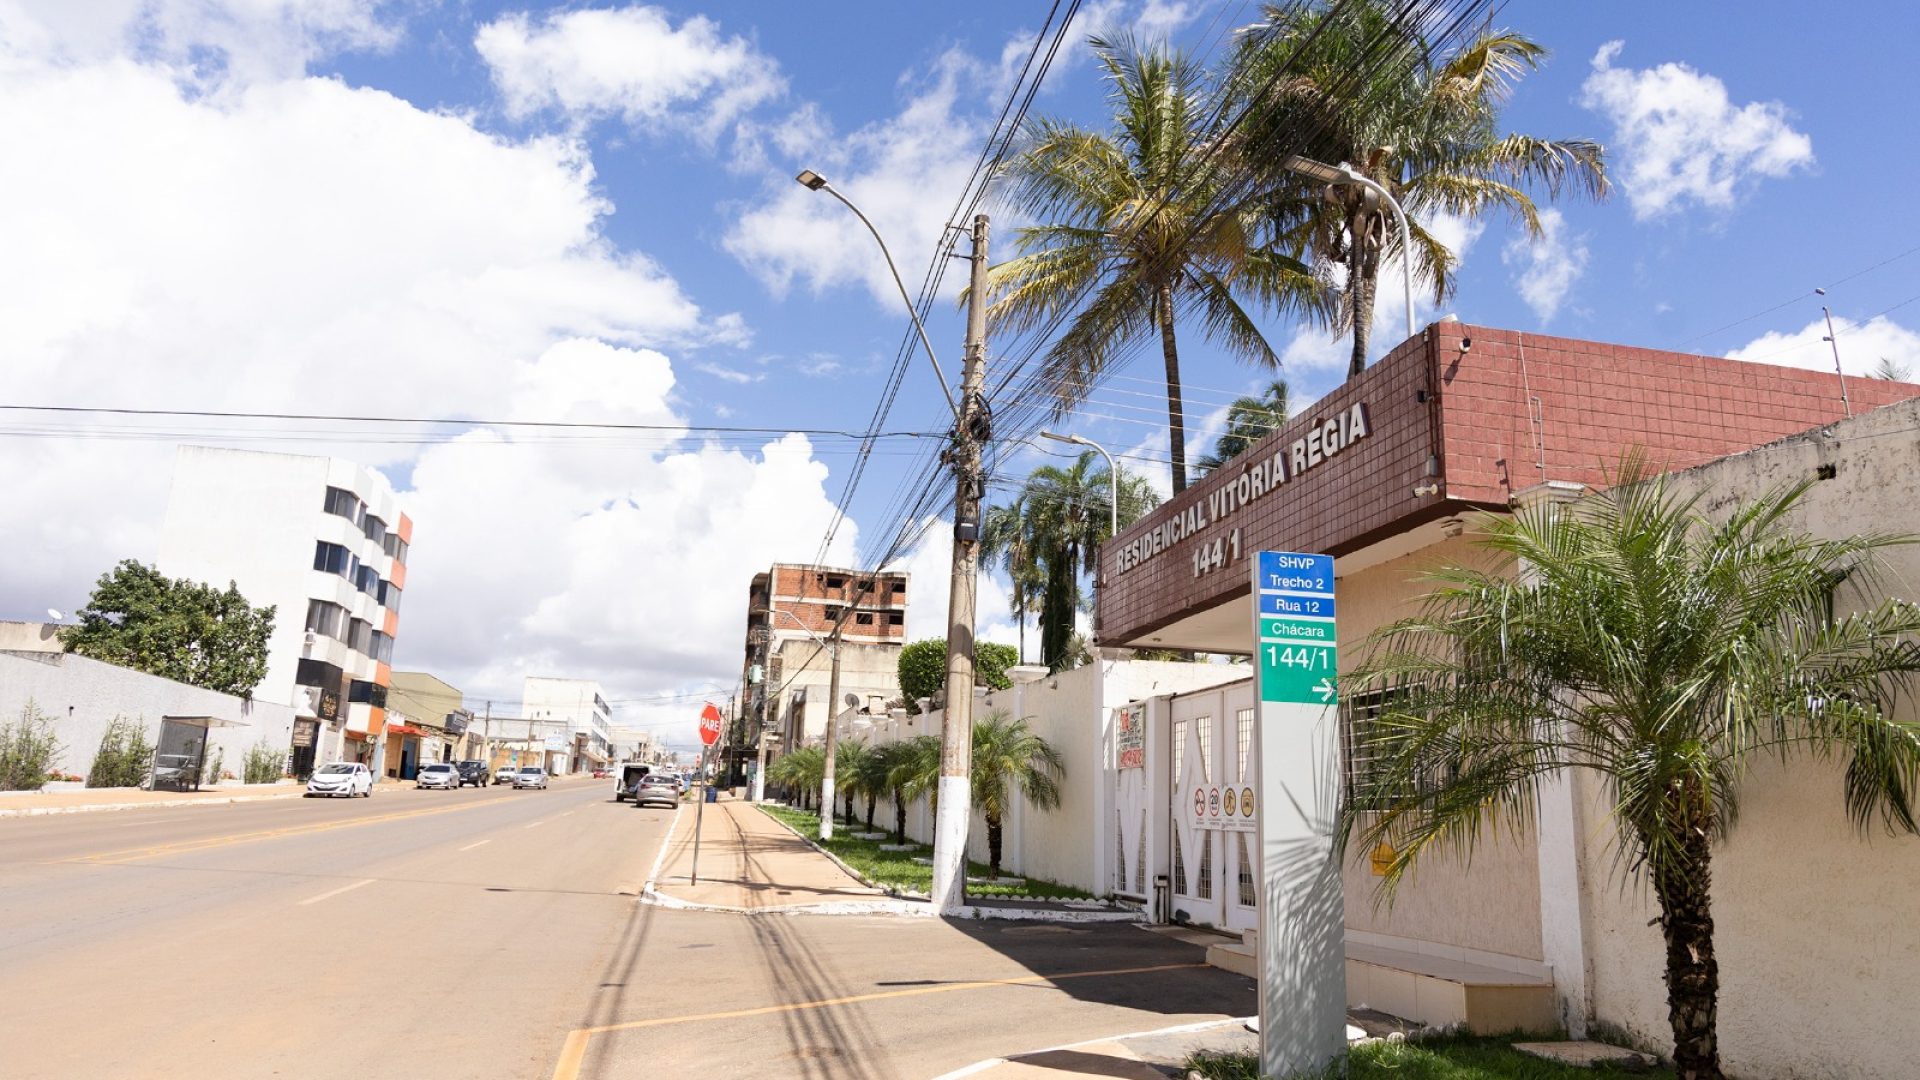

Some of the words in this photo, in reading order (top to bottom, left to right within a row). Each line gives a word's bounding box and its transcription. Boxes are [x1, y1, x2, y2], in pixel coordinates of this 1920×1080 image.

[1116, 502, 1206, 575] RESIDENCIAL
[1209, 451, 1287, 522] VITÓRIA
[1291, 402, 1370, 477] RÉGIA
[1192, 528, 1242, 578] 144/1
[1278, 556, 1315, 570] SHVP
[1270, 574, 1313, 589] Trecho
[1315, 579, 1324, 590] 2
[1276, 599, 1302, 612] Rua
[1305, 601, 1320, 613] 12
[1271, 622, 1325, 637] Chácara
[1266, 645, 1328, 671] 144/1
[701, 717, 720, 732] PARE
